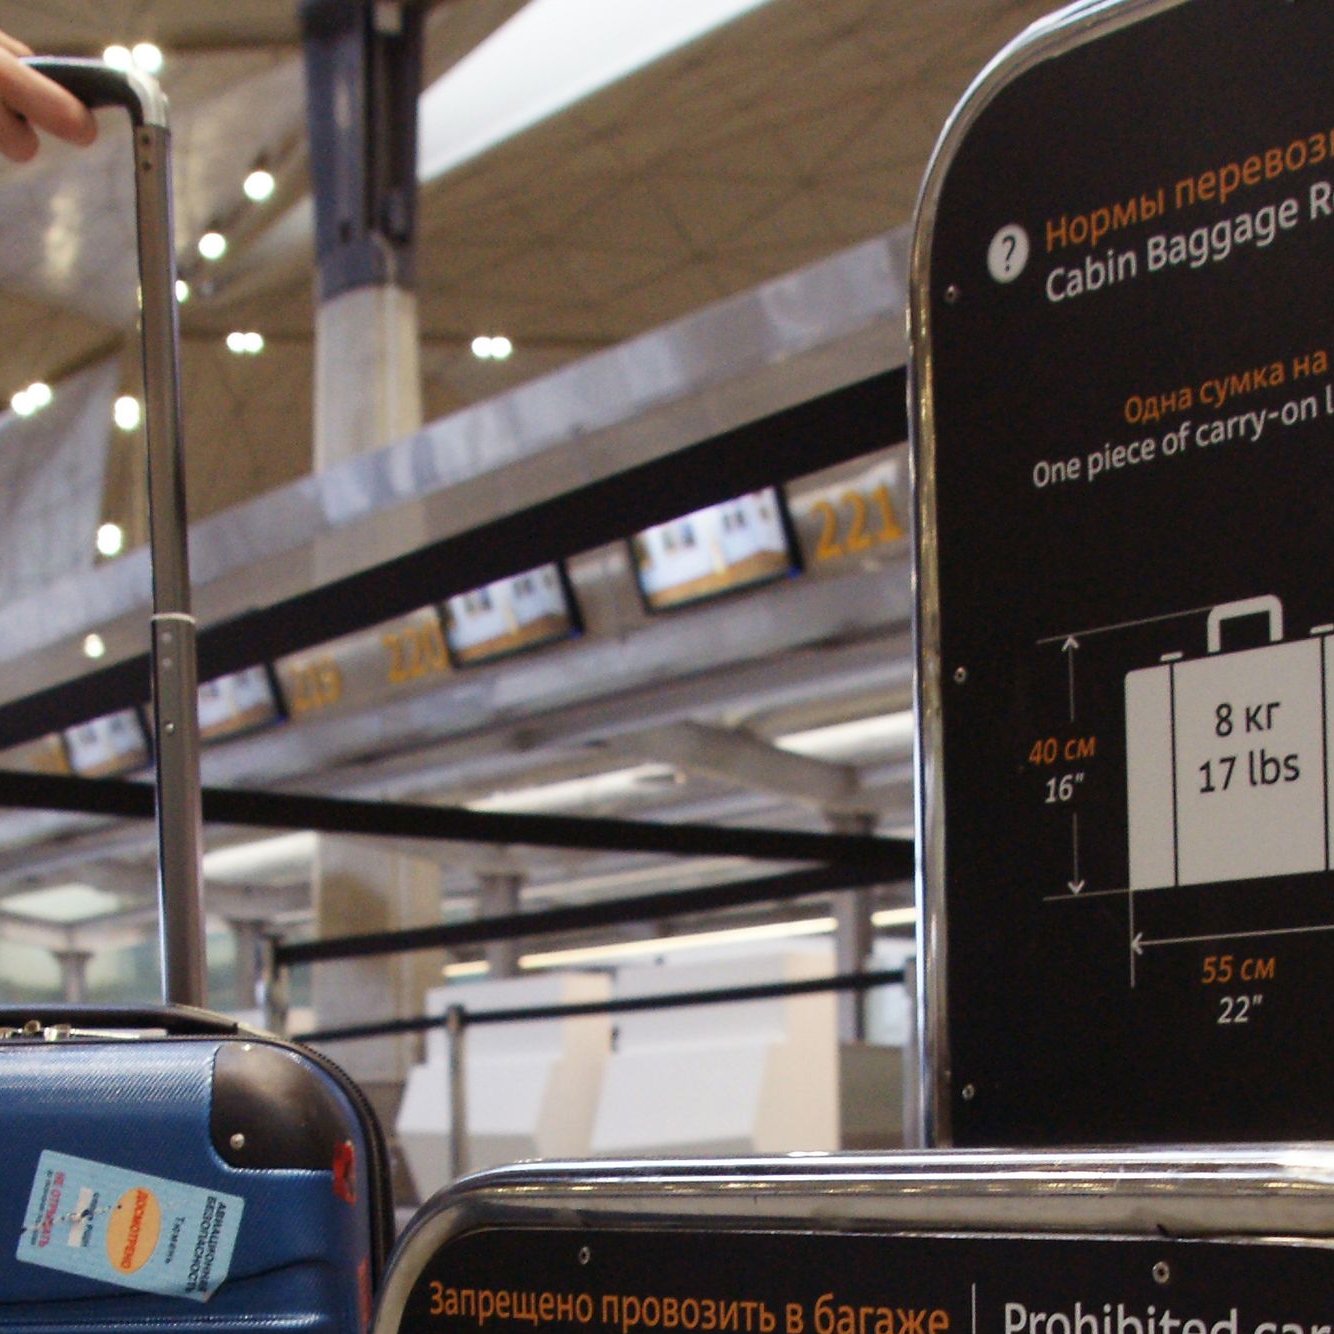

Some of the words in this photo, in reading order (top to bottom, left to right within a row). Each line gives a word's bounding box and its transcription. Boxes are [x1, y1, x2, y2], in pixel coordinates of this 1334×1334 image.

[1047, 188, 1164, 252] Нормы
[1046, 248, 1137, 302] Cabin
[1148, 197, 1299, 271] Baggage
[1125, 387, 1192, 423] Одна
[1200, 361, 1284, 408] сумка
[1294, 350, 1327, 378] на
[1033, 457, 1081, 488] One
[1088, 438, 1156, 481] piece
[1162, 420, 1191, 456] of
[1196, 395, 1317, 447] carry-on
[812, 483, 906, 561] 221
[1215, 702, 1234, 738] 8
[1245, 701, 1281, 733] кг
[1028, 737, 1058, 764] 40
[1064, 736, 1096, 761] см
[1199, 755, 1237, 794] 17
[1248, 748, 1301, 787] lbs
[1045, 772, 1085, 803] 16"
[1202, 954, 1233, 984] 55
[1240, 957, 1276, 981] см
[1217, 994, 1263, 1024] 22"
[120, 1190, 149, 1270] ДОСМОТРЕНО
[430, 1281, 593, 1326] Запрещено
[603, 1295, 776, 1334] провозить
[786, 1303, 803, 1334] в
